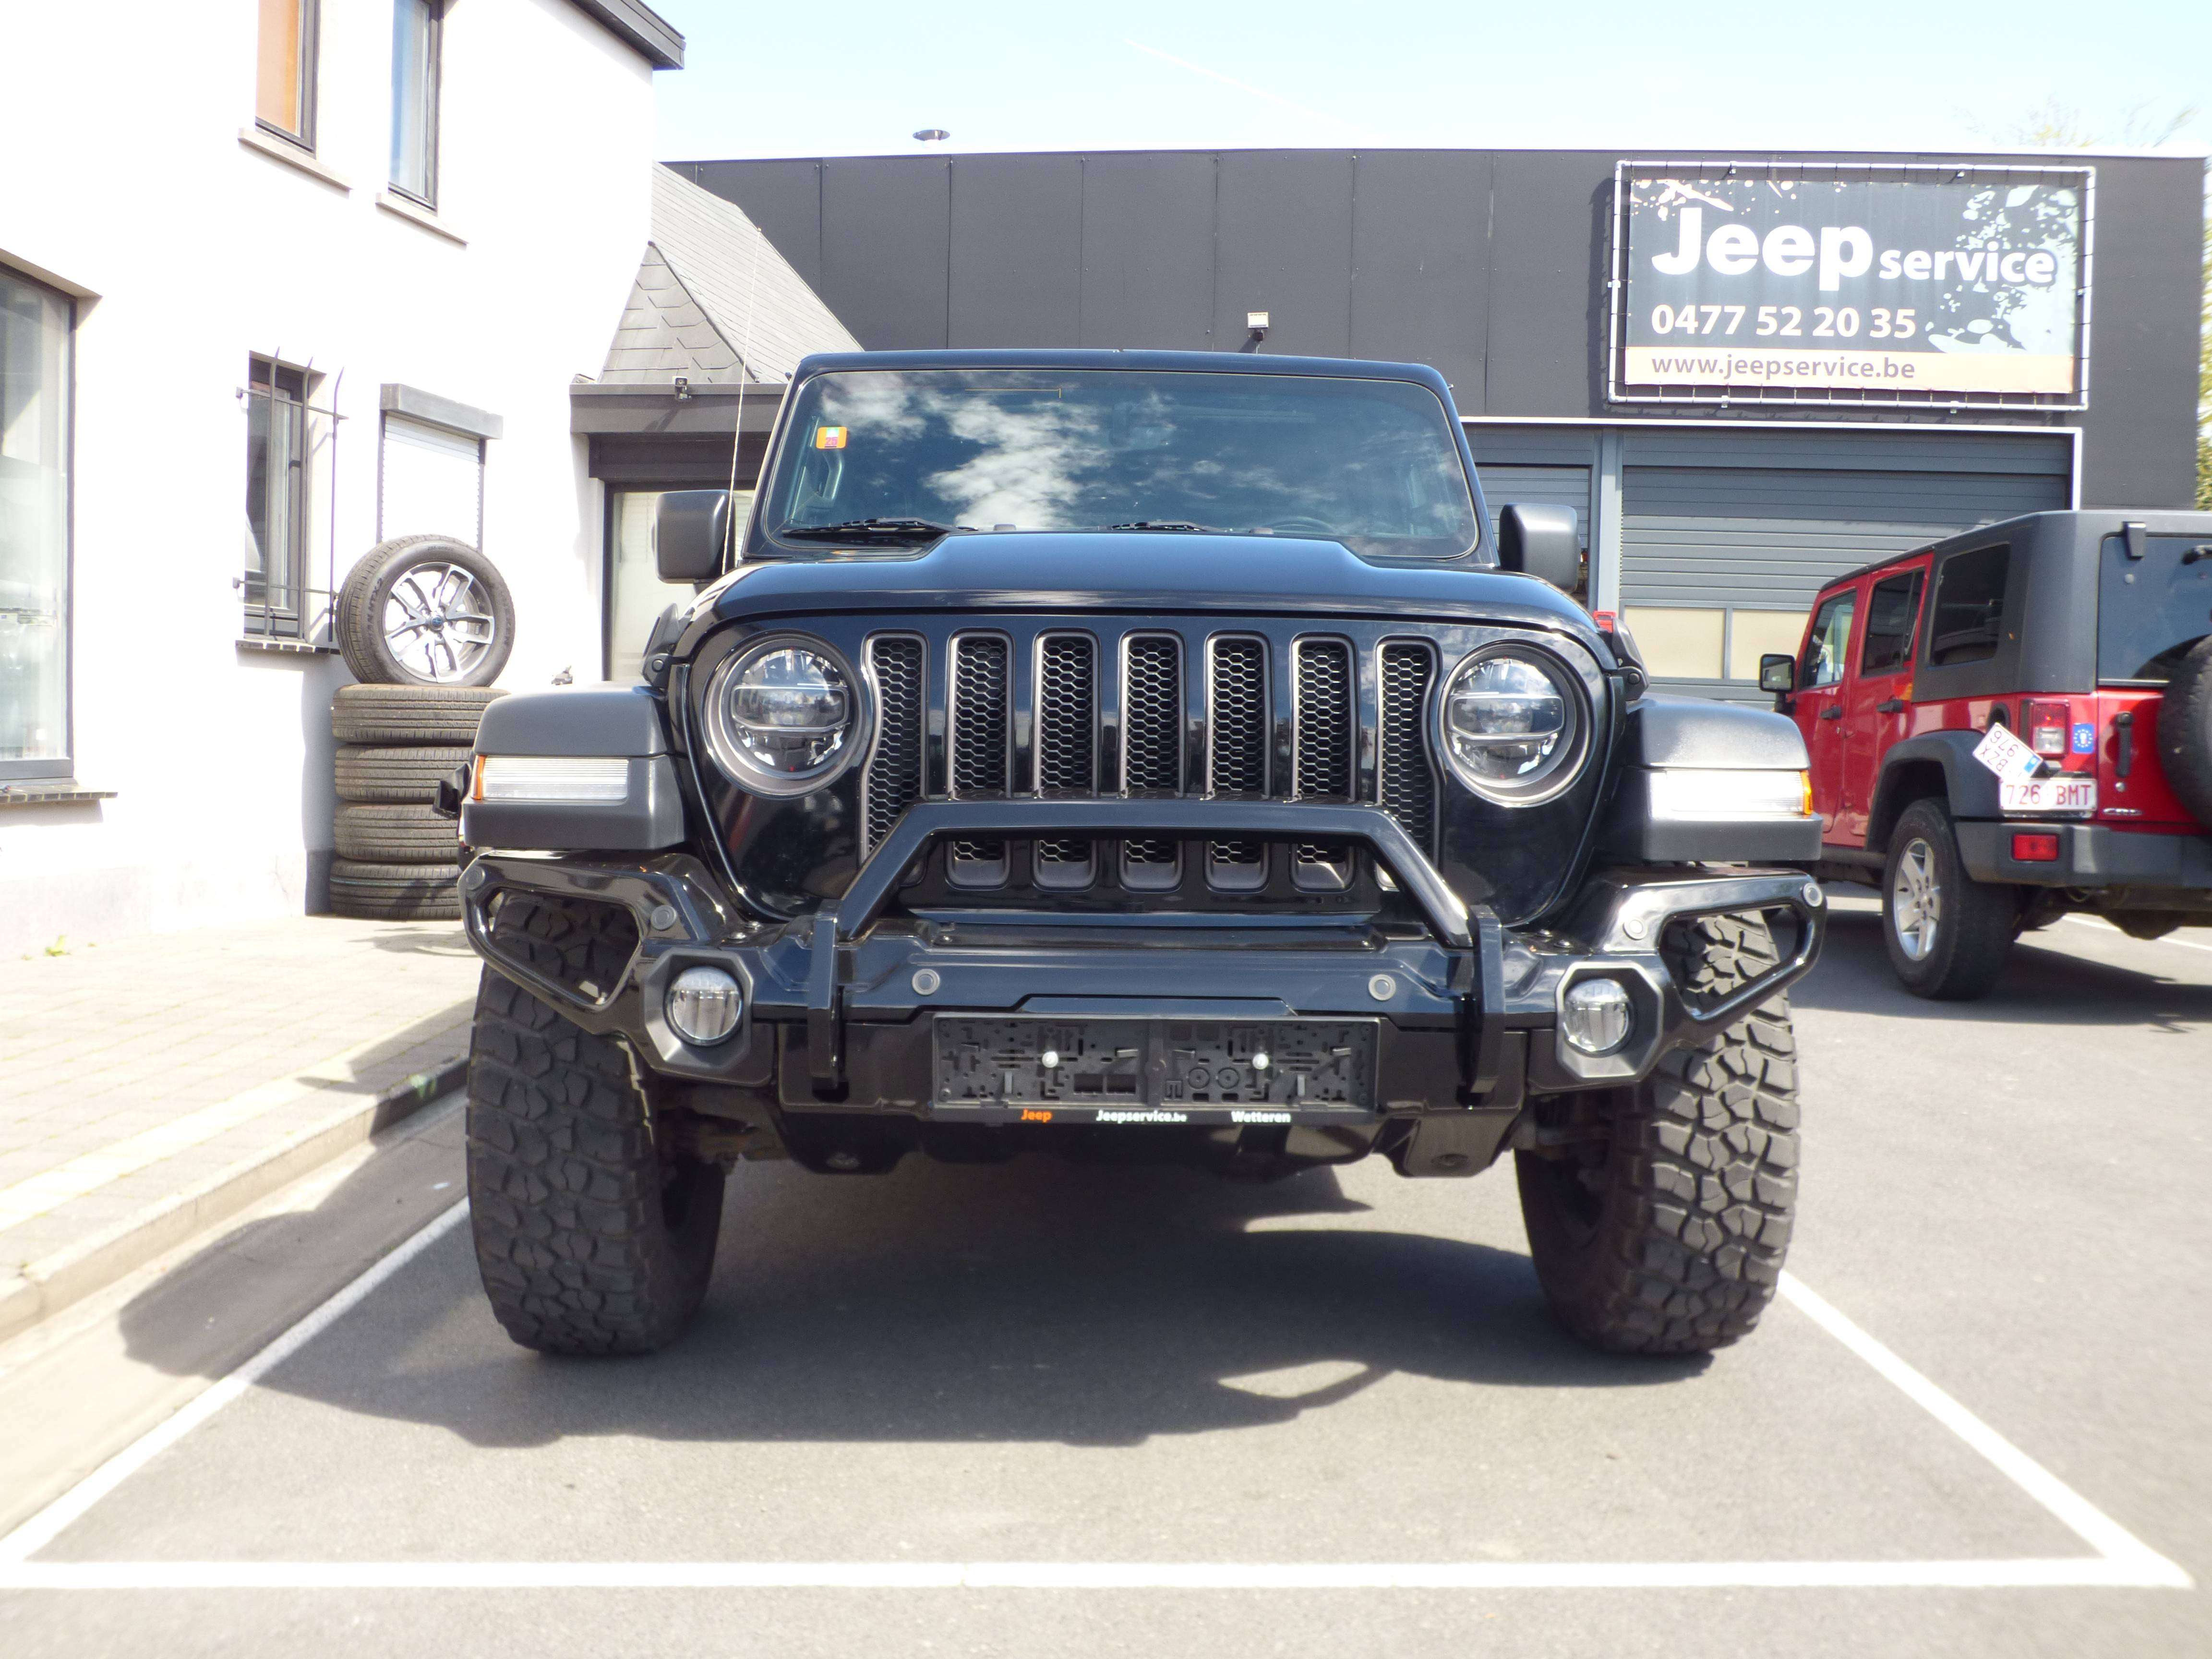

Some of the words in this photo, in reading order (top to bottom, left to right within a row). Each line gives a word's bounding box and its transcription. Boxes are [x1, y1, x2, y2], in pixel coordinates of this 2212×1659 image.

[1651, 207, 1873, 291] Jeep
[1878, 240, 2055, 283] service
[1651, 304, 1746, 335] 0477
[1755, 306, 1802, 336] 52
[1812, 307, 1860, 337] 20
[1869, 308, 1916, 338] 35
[1651, 354, 1915, 380] www.jeepservice.be
[1990, 730, 2020, 757] 976
[2006, 784, 2041, 805] 726
[2056, 784, 2092, 805] BMT
[1021, 1108, 1052, 1124] Jeep
[1095, 1109, 1187, 1124] Jeepservice.be
[1231, 1111, 1291, 1123] Wetteren
